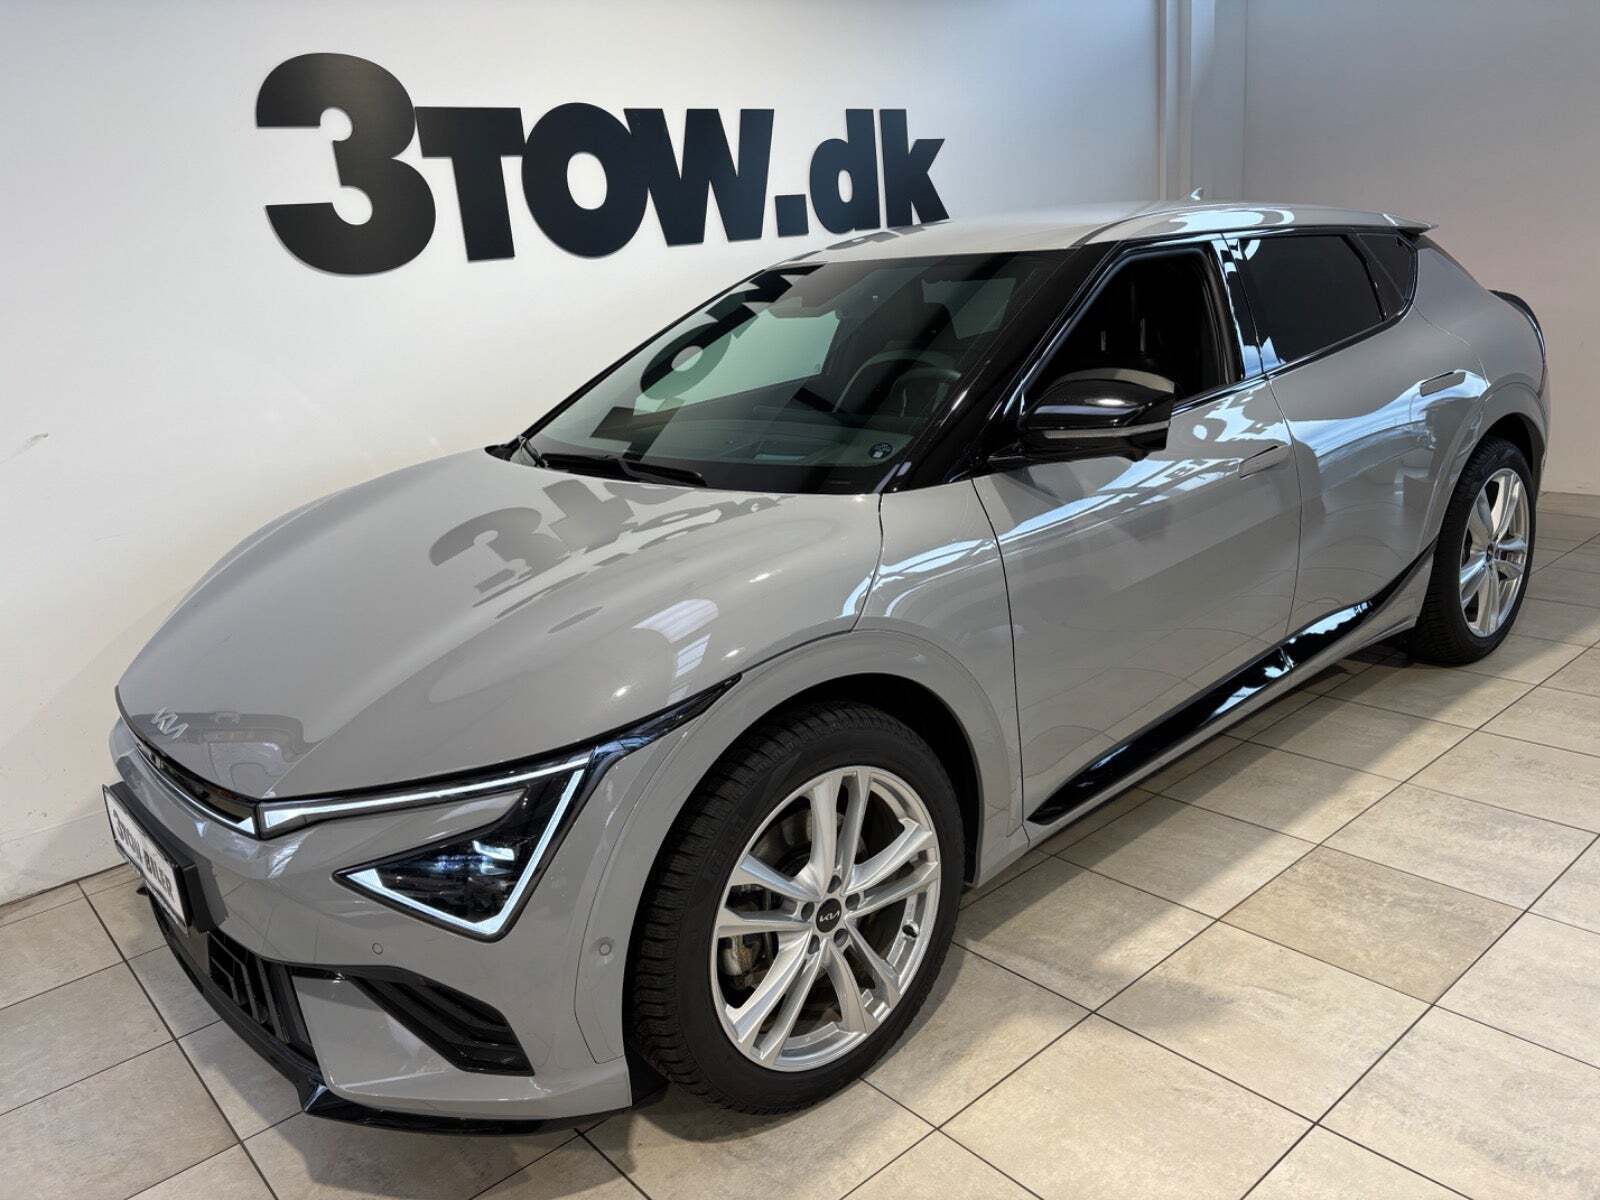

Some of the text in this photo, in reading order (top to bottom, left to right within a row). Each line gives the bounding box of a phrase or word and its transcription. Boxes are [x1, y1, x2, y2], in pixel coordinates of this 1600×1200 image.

[256, 53, 949, 275] 3TOW.dk
[151, 707, 189, 739] KIA
[819, 909, 840, 922] KIA
